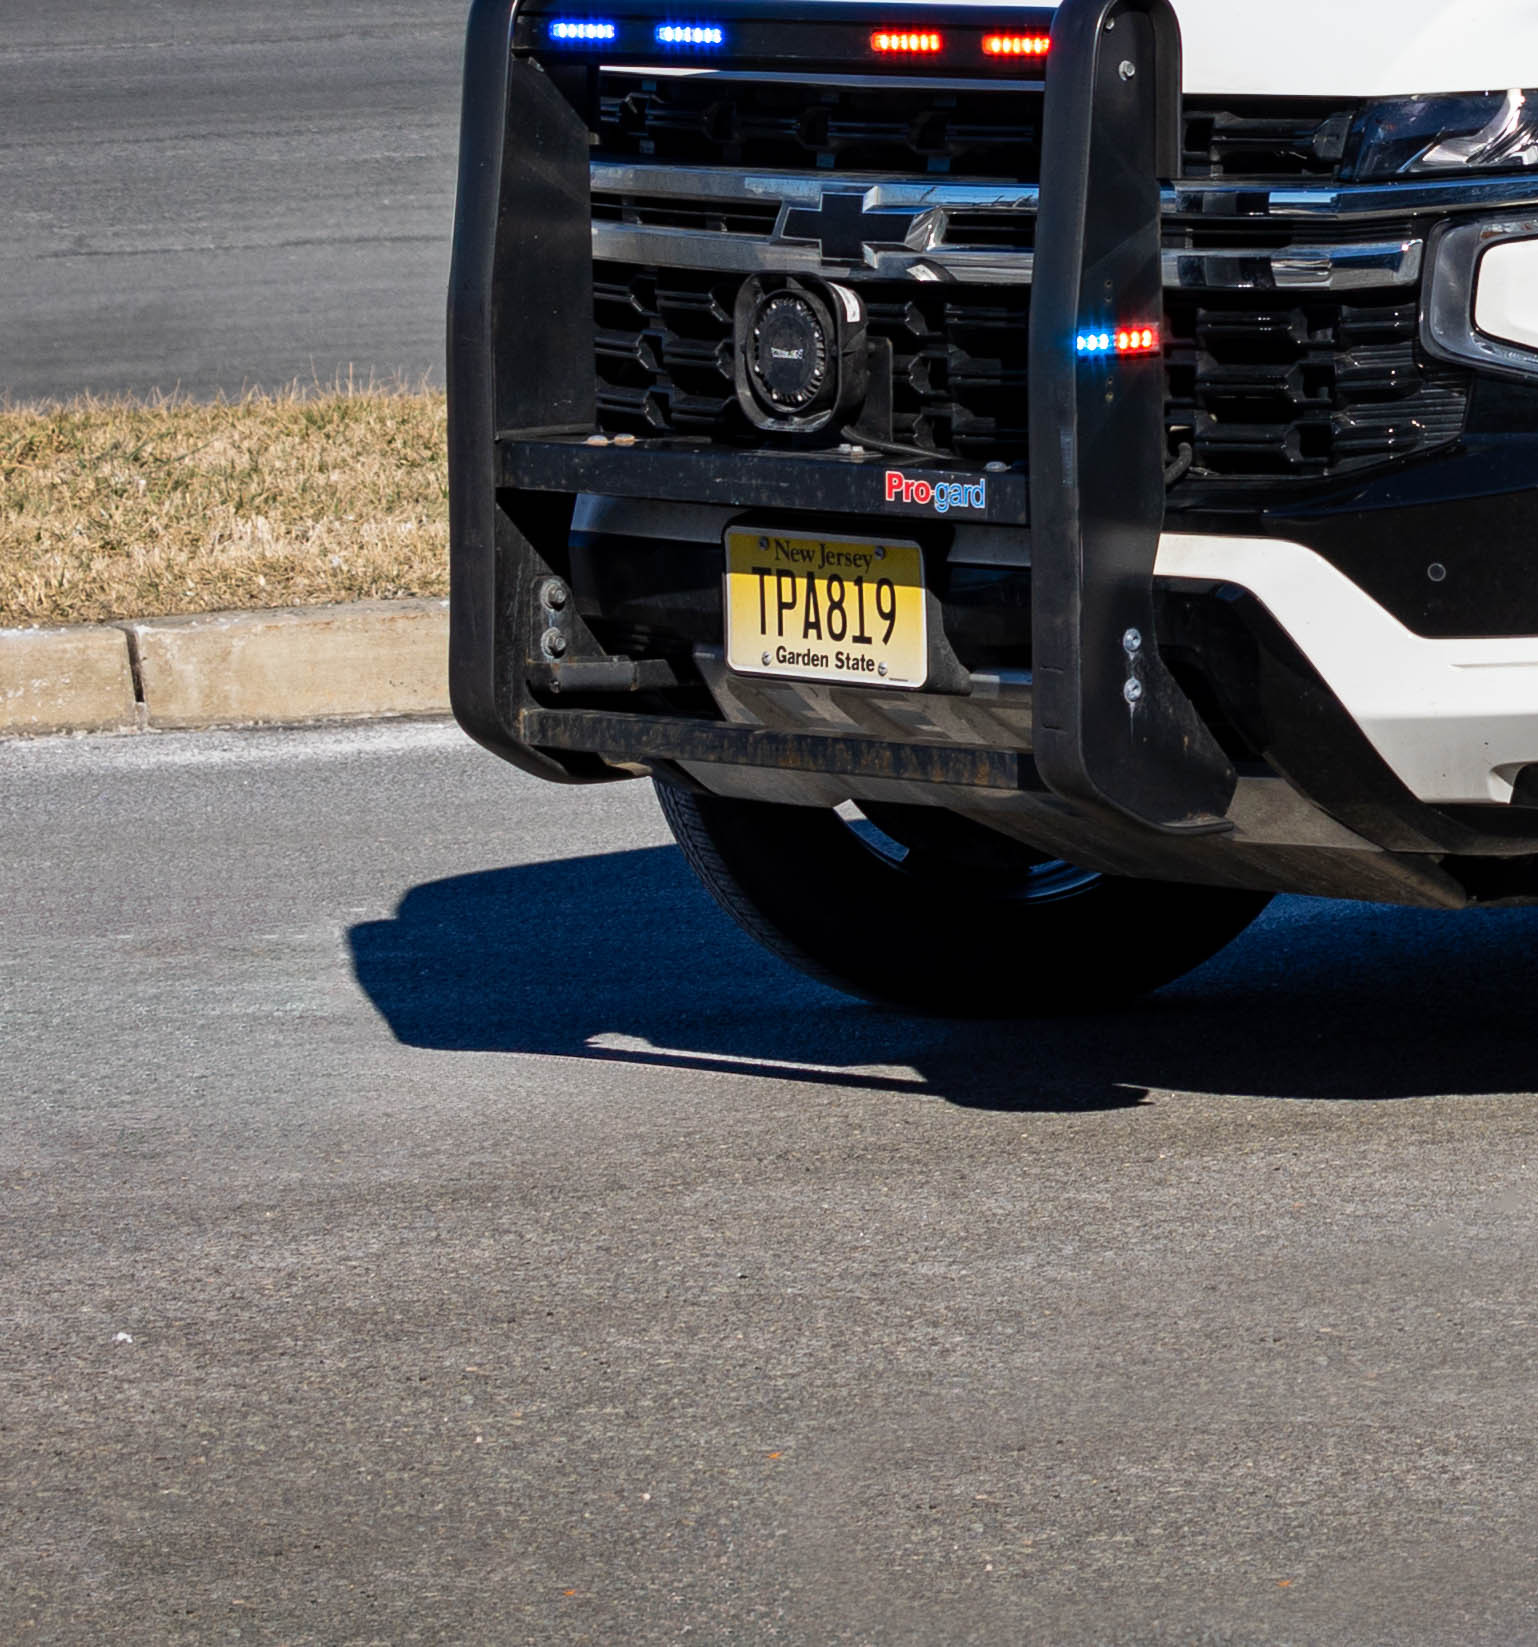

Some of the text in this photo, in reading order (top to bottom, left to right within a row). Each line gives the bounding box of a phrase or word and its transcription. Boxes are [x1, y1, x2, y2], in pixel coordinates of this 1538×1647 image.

[774, 538, 873, 574] New Jersey
[751, 566, 897, 646] TPA819
[775, 645, 876, 673] Garden State
